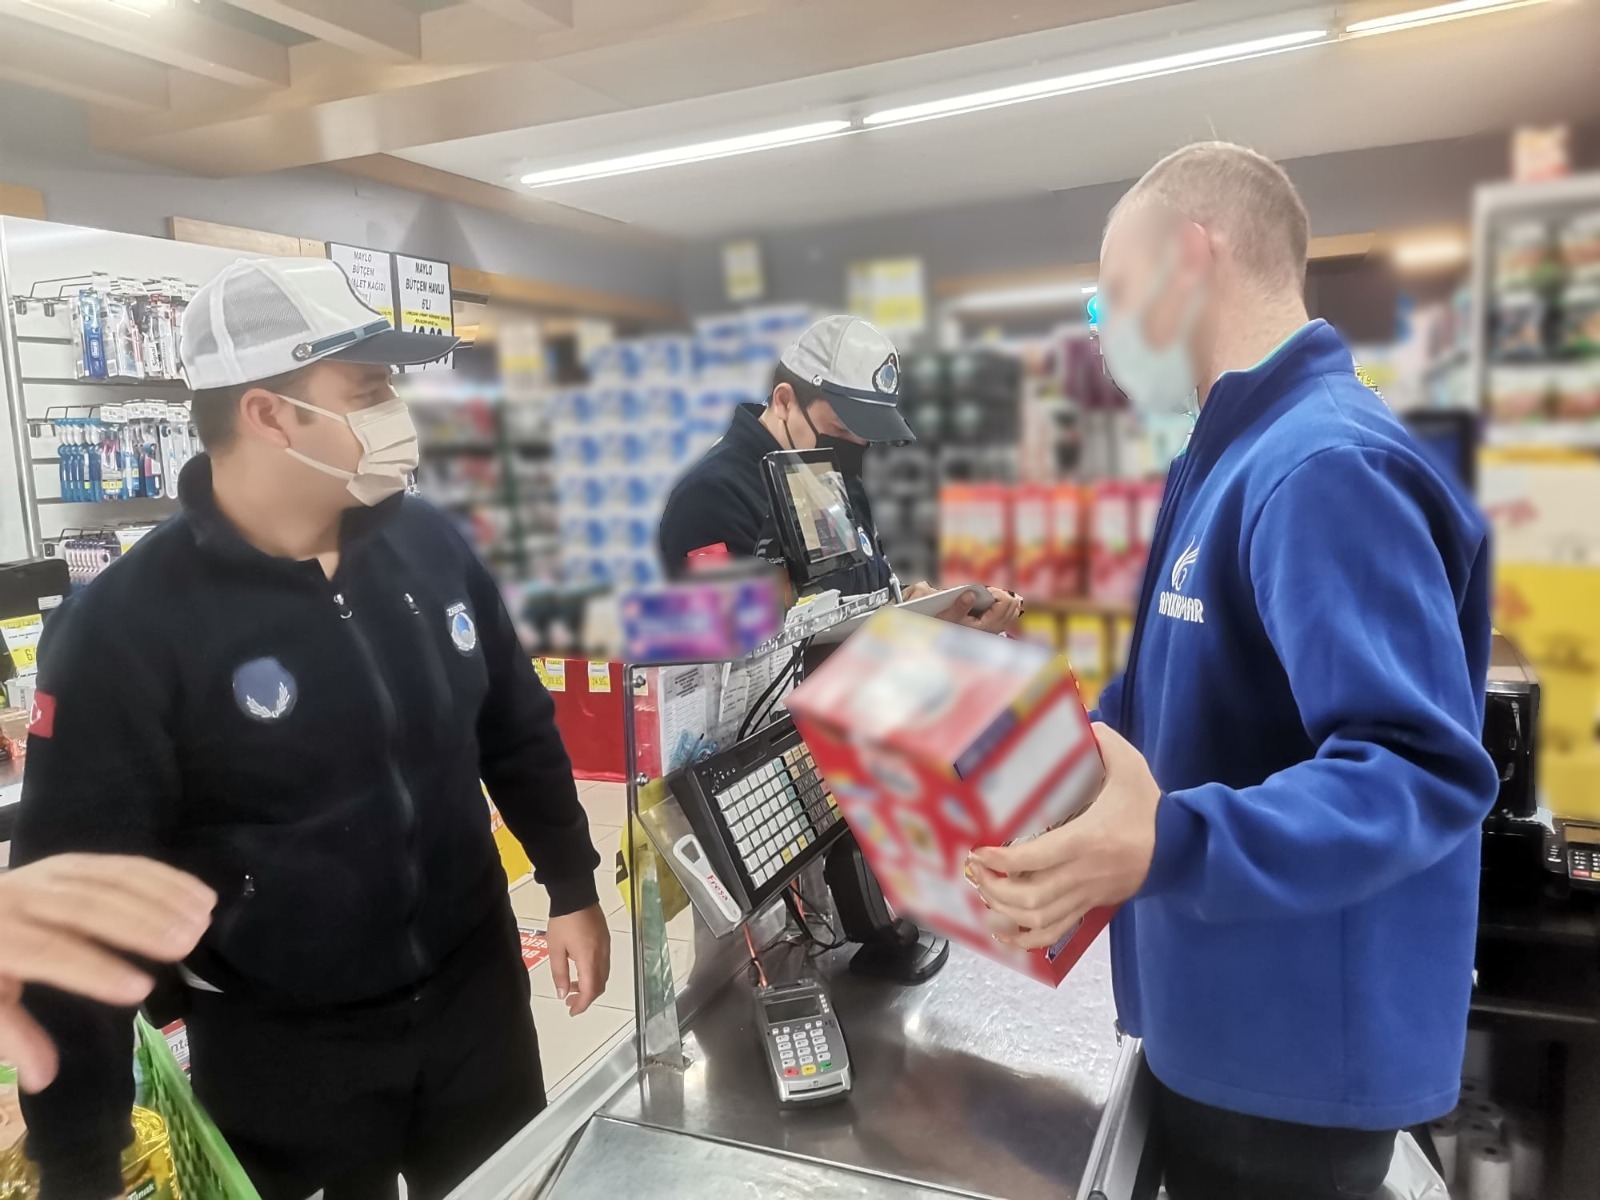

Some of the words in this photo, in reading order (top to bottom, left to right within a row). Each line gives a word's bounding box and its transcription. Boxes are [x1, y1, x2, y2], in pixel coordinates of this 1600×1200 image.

[353, 250, 372, 263] MAYLO
[415, 262, 433, 275] MAYLO
[405, 277, 427, 293] BÜTÇEM
[428, 282, 445, 295] HAVLU
